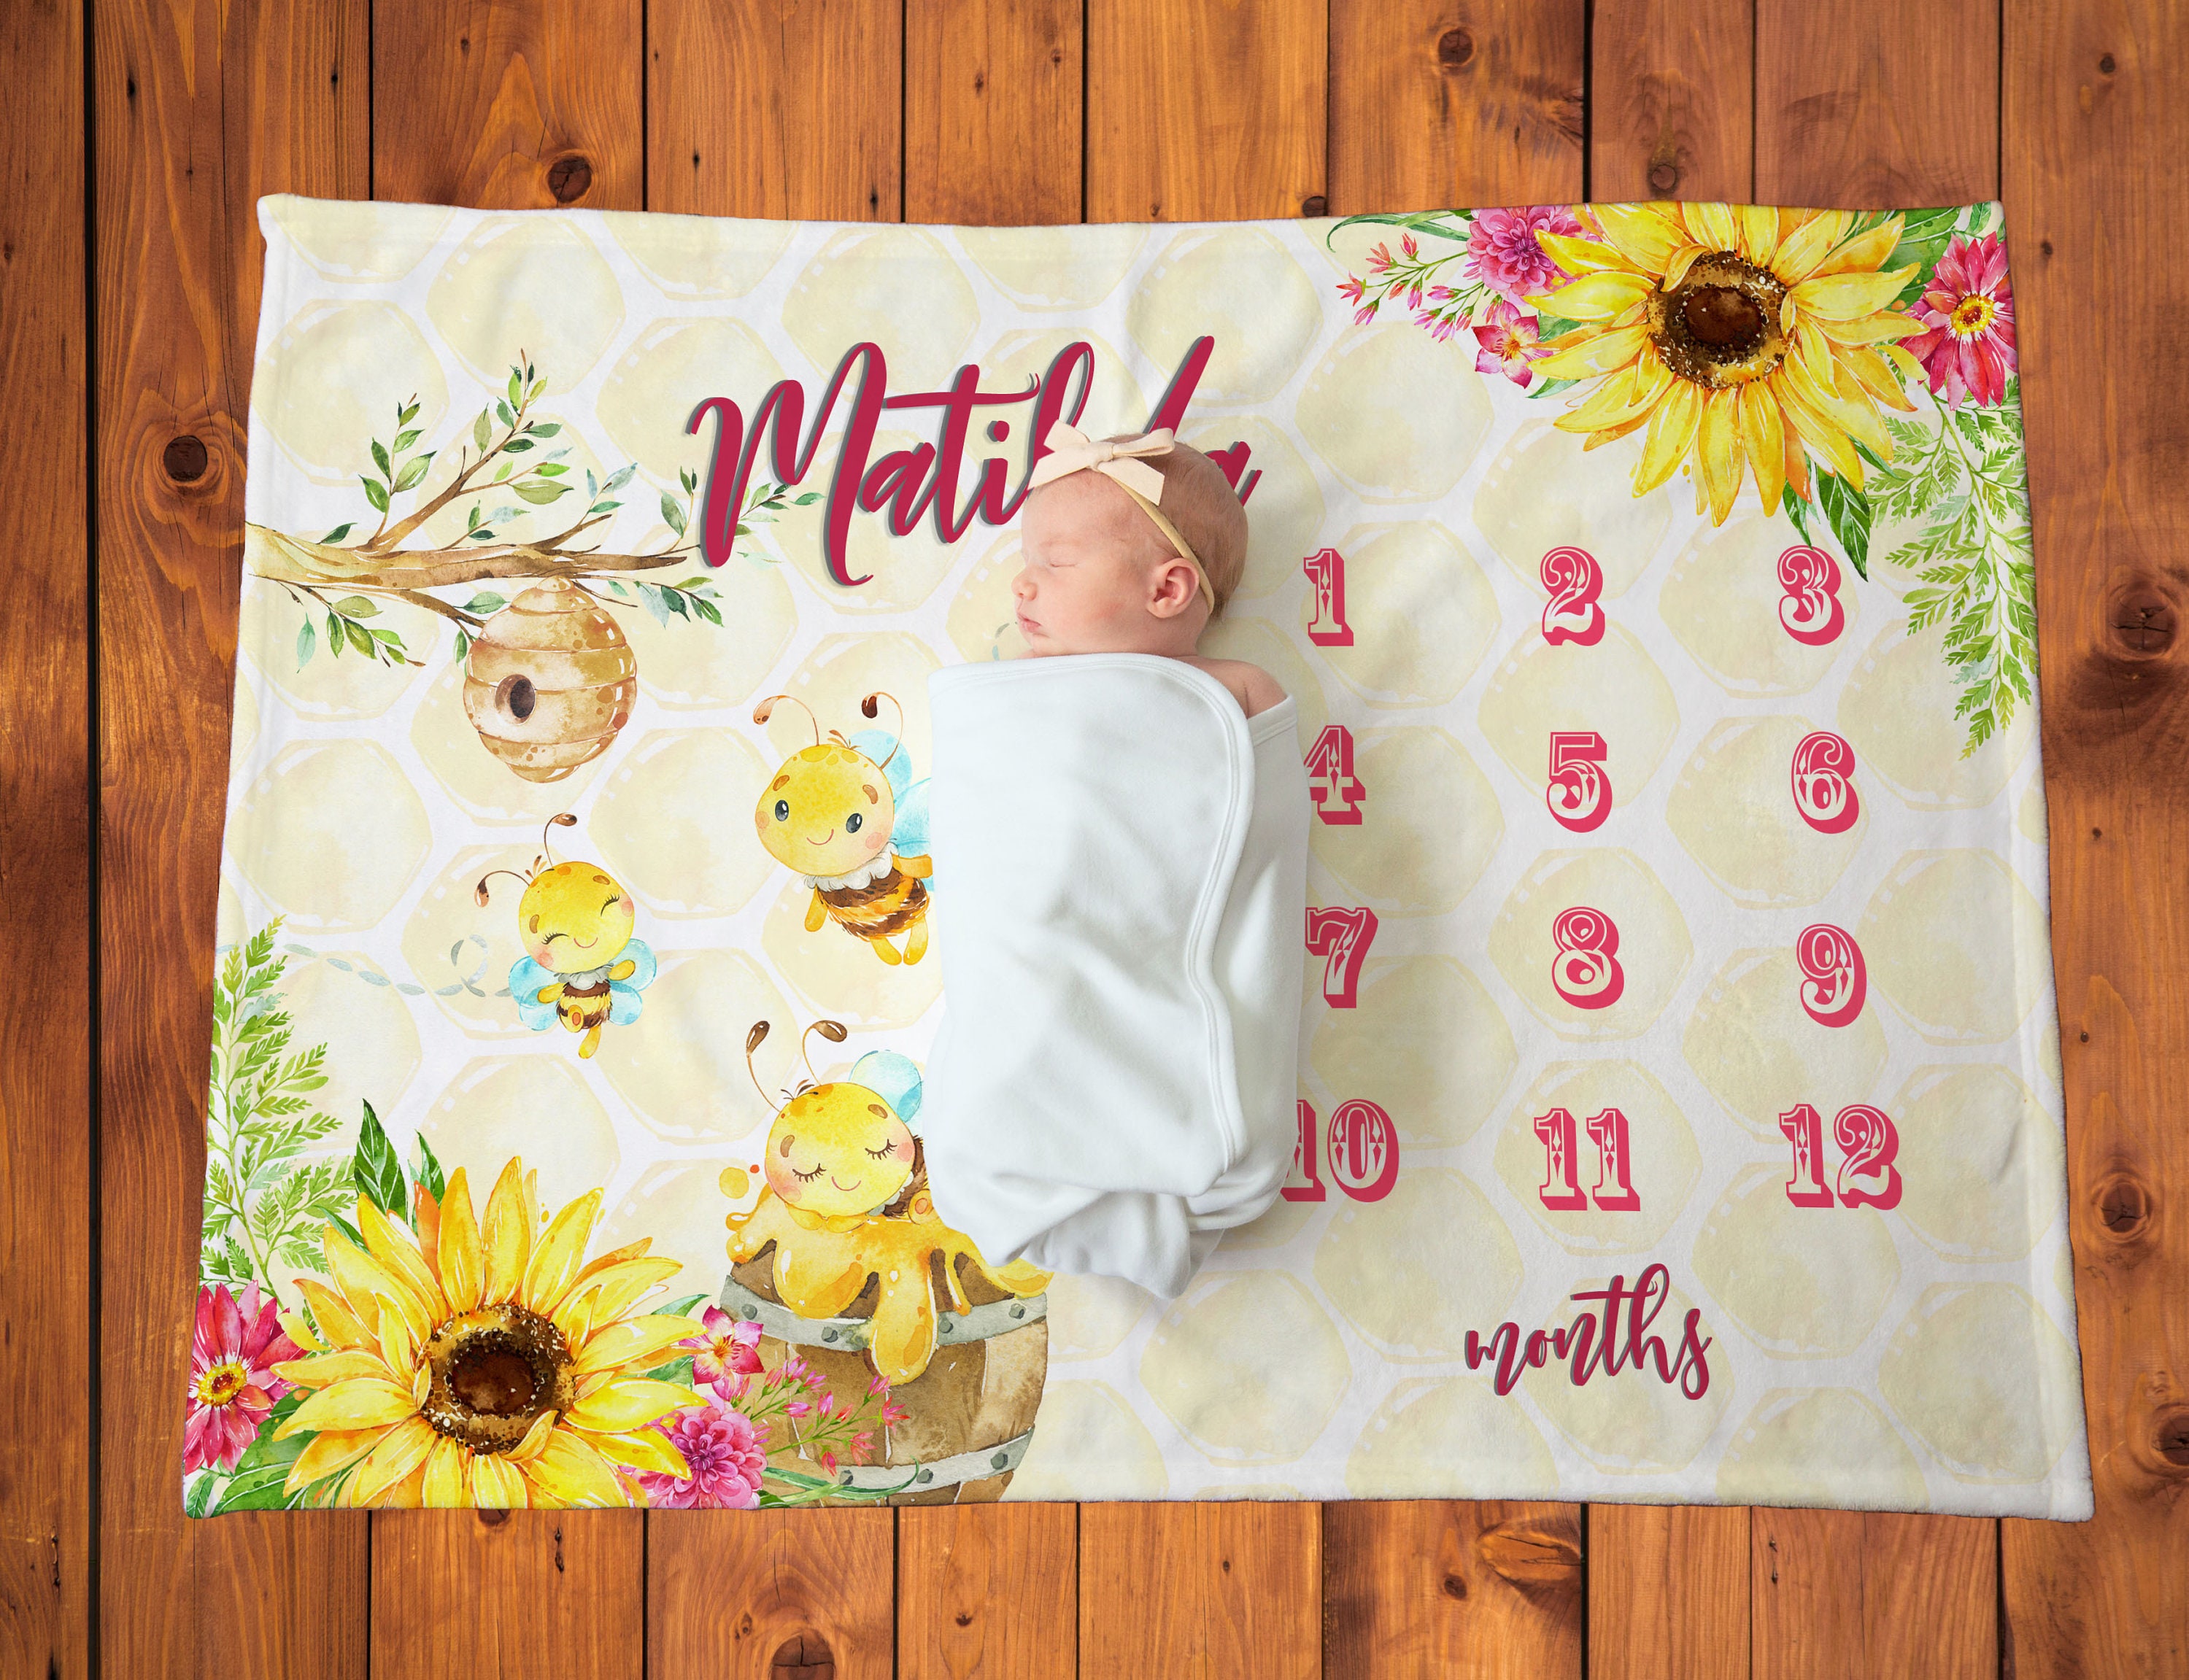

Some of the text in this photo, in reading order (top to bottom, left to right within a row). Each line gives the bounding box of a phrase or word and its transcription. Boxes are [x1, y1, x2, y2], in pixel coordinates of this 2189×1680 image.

[686, 336, 1263, 586] Matil
[1303, 545, 1845, 647] 1 2 3
[1303, 725, 1860, 835] 4 5 6
[1305, 906, 1867, 1028] 7 8 9
[1533, 1107, 1641, 1212] 11
[1778, 1104, 1902, 1210] 12
[1464, 1263, 1713, 1401] months
